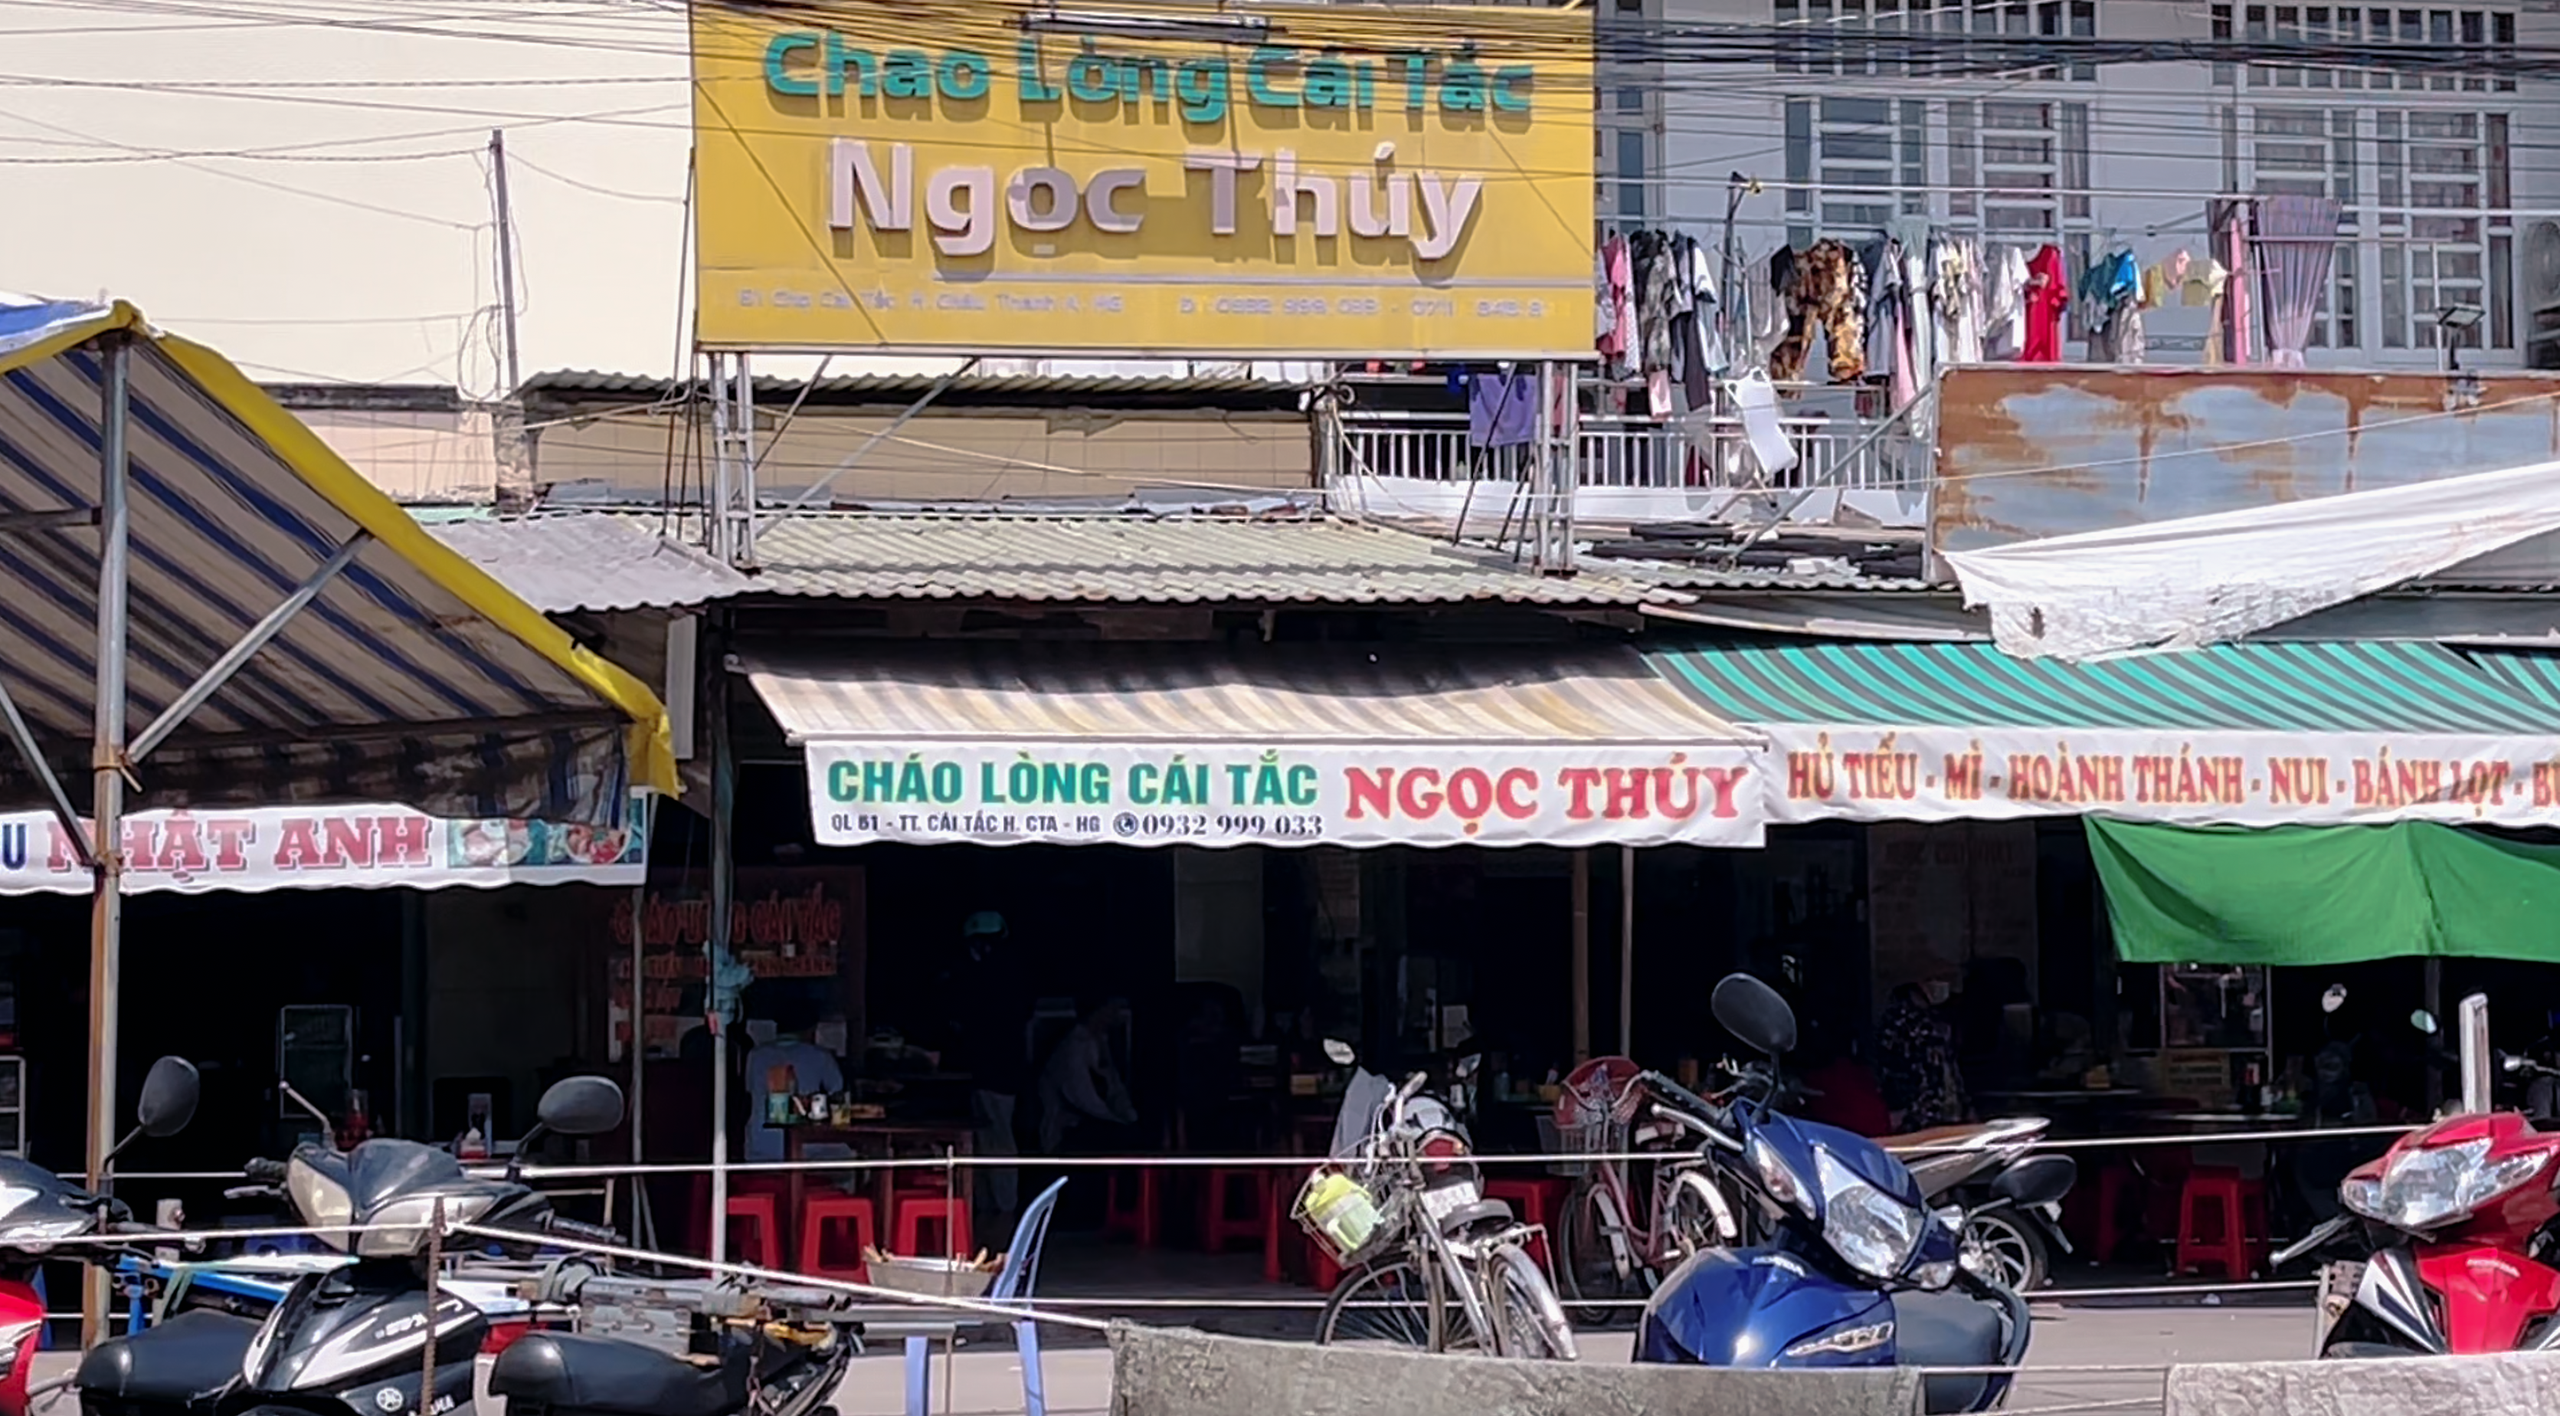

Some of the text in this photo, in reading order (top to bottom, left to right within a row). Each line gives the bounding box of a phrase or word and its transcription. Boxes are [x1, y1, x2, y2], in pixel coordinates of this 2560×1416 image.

[828, 137, 1484, 259] Ngọc Thúy
[828, 749, 1319, 806] CHÁO LÒNG CÁI TẮC
[1344, 752, 1748, 834] NGỌC THÚY
[1788, 732, 1834, 799] HỦ
[1843, 731, 1917, 800] TIẾU
[1944, 738, 1982, 800] MÌ
[2007, 740, 2124, 801] HOÀNH
[2132, 741, 2243, 803] THÁNH
[2268, 756, 2329, 804] NUI
[2352, 745, 2440, 805] BÁNH
[274, 816, 432, 869] ANH
[831, 814, 852, 832] QL
[927, 811, 958, 831] CÁI
[1025, 814, 1058, 832] CTA
[1076, 816, 1100, 833] HG
[1143, 814, 1322, 836] 0932 999 033
